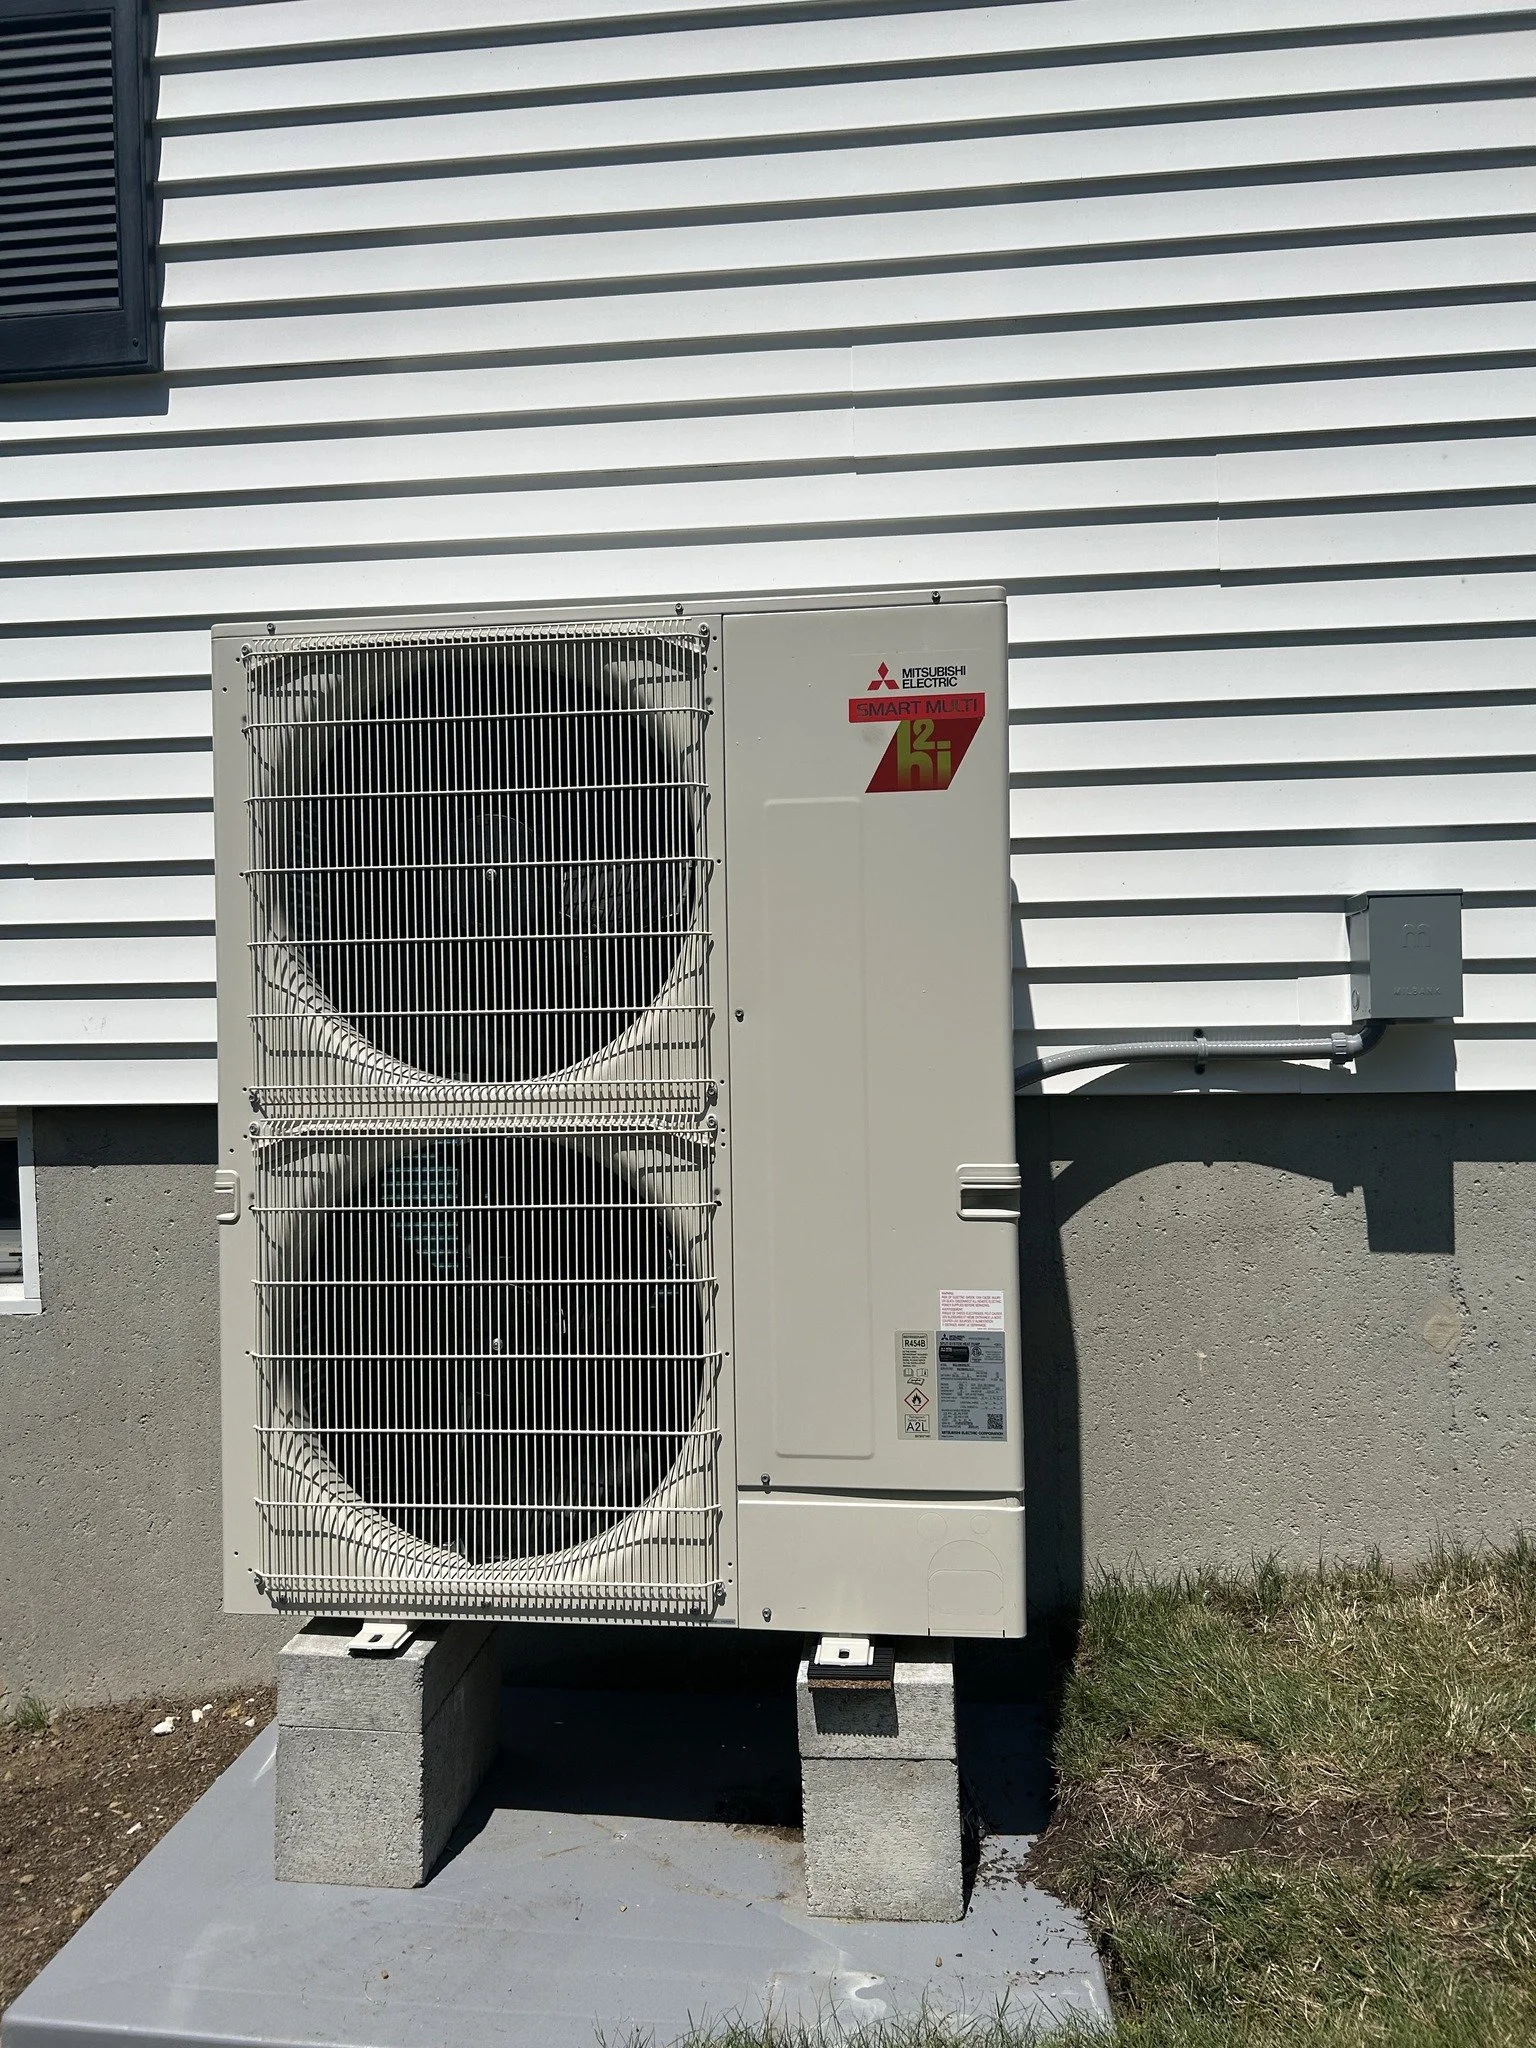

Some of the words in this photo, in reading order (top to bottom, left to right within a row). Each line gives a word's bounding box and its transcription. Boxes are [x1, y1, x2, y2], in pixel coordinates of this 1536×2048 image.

[902, 666, 966, 679] MITSUBISHI
[902, 677, 958, 689] ELECTRIC
[856, 700, 921, 716] SMART
[926, 698, 977, 713] MULTI
[1393, 986, 1441, 997] MILBANK
[904, 1339, 926, 1347] R454B
[906, 1421, 929, 1431] A2L
